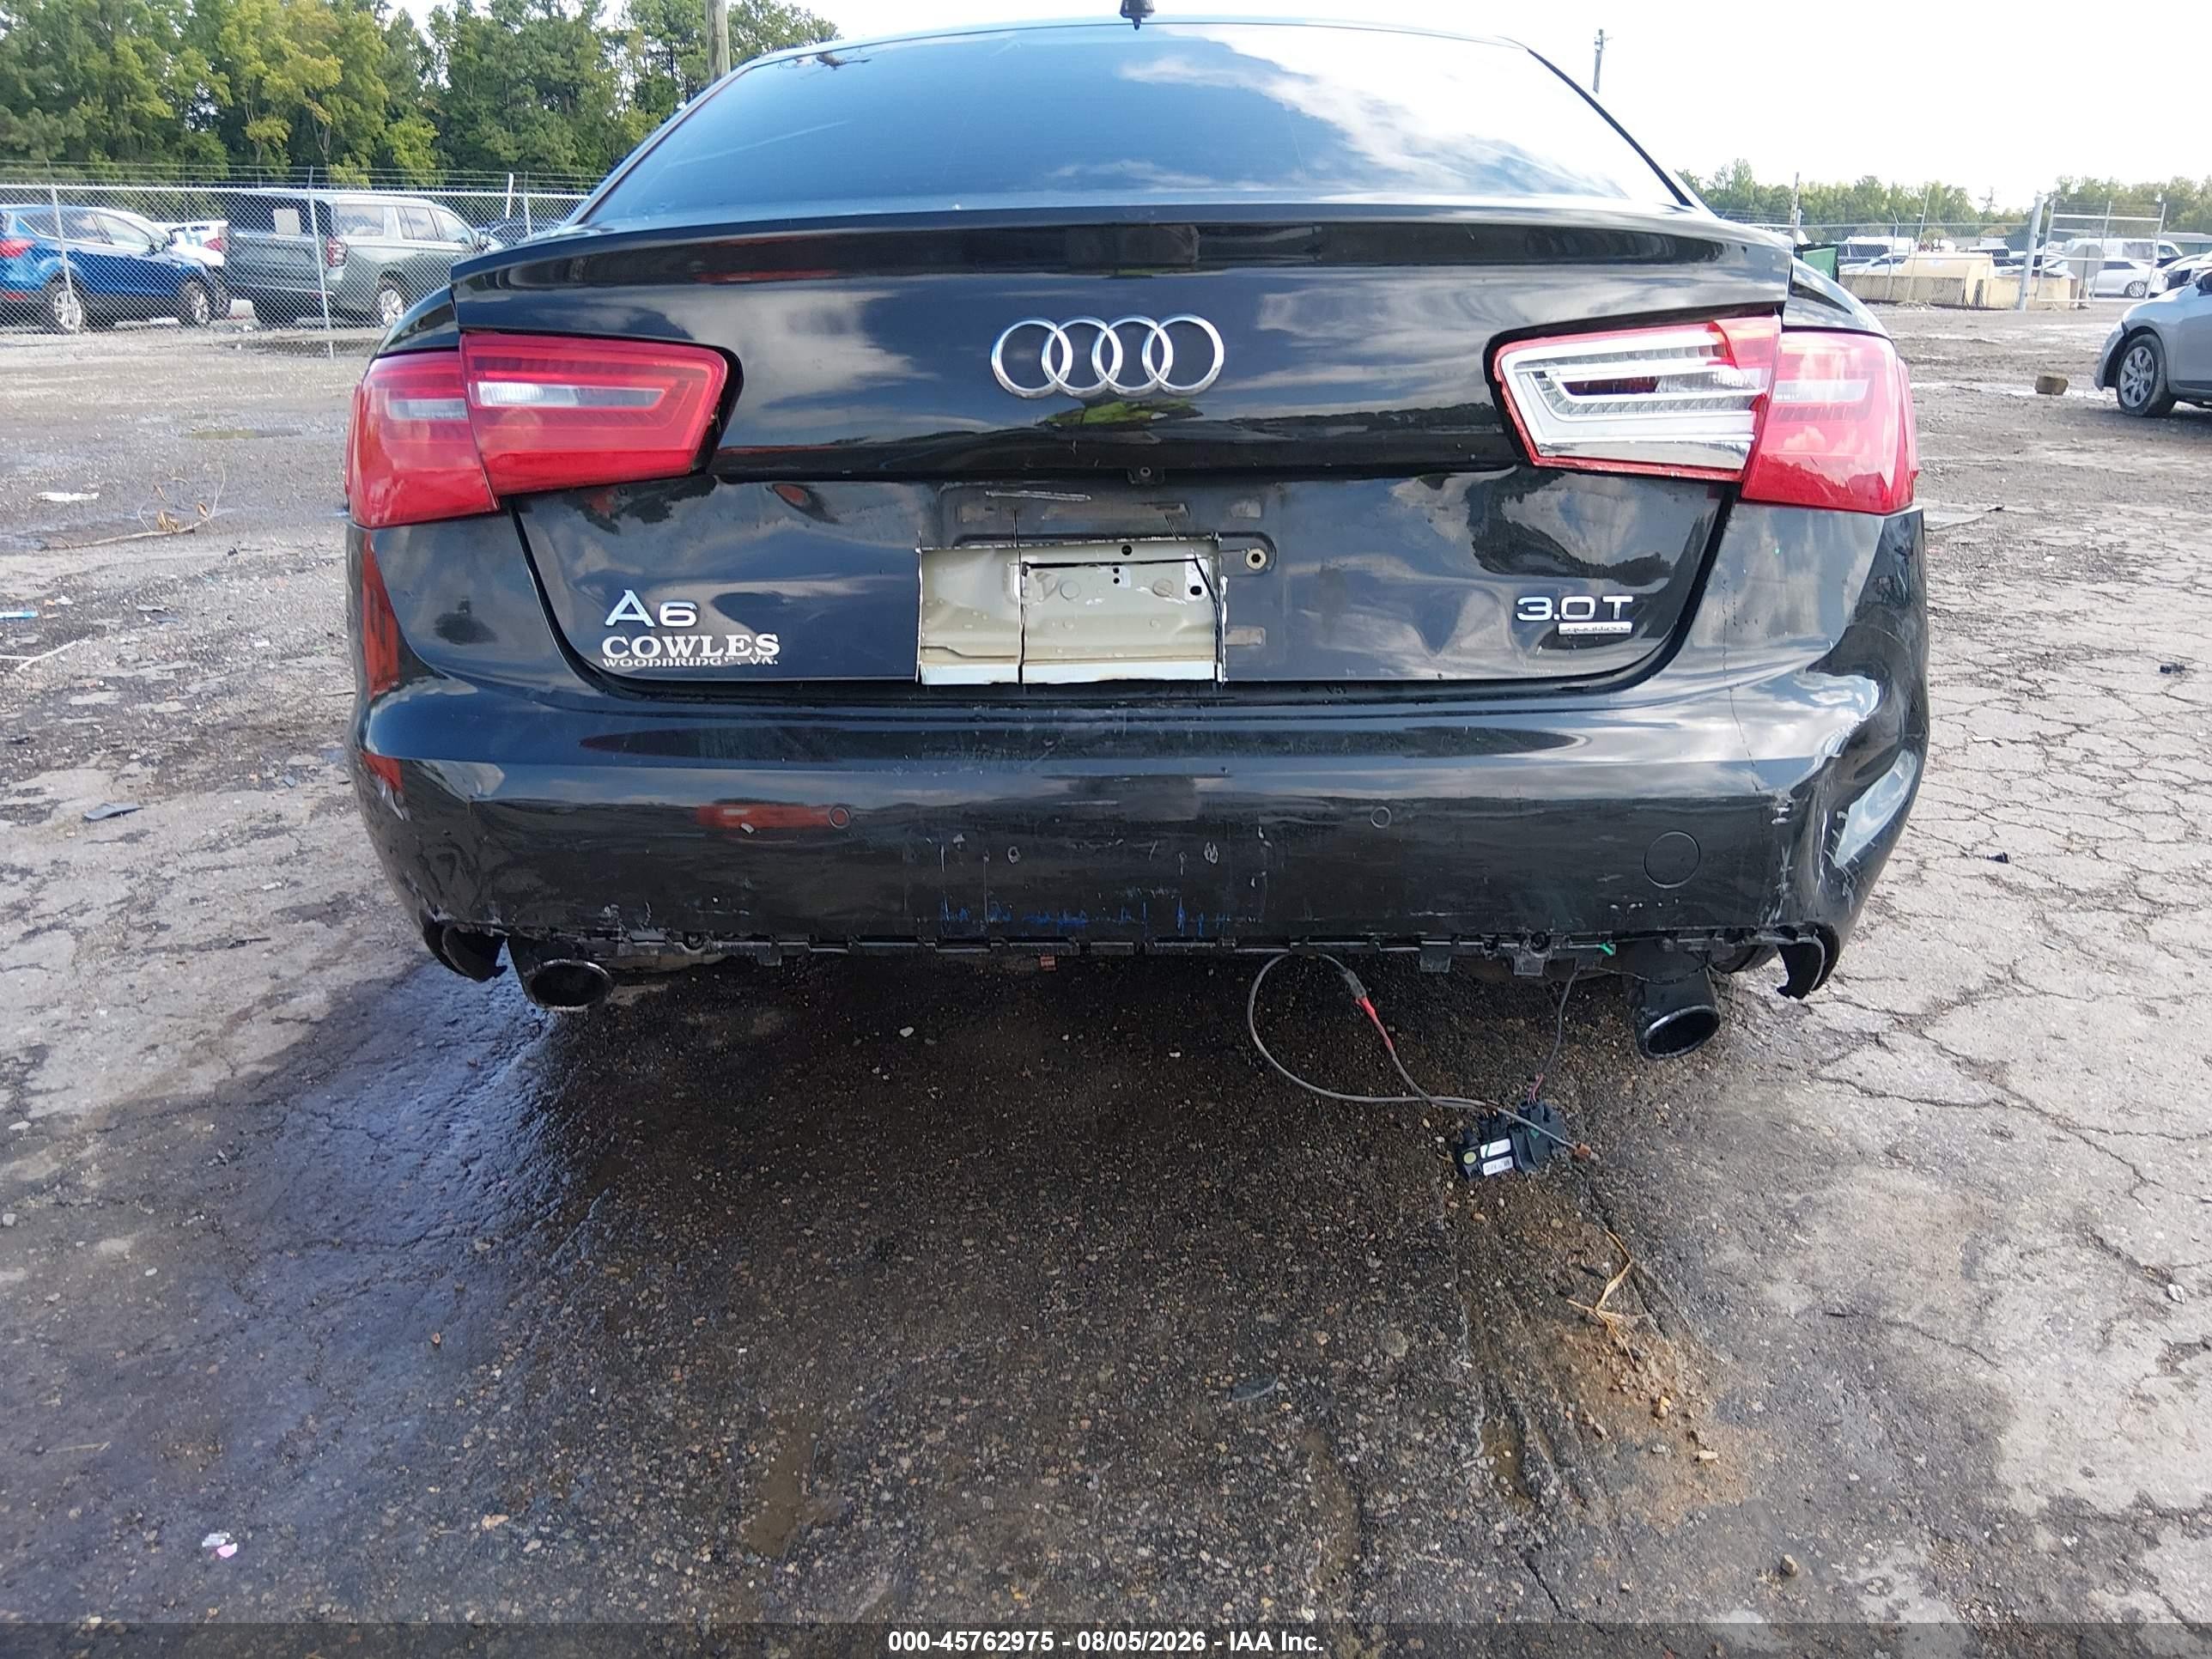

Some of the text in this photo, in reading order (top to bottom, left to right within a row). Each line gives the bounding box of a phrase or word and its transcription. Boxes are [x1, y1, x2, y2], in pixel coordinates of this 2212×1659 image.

[605, 589, 698, 628] A6
[1516, 595, 1633, 621] 3.0T
[602, 634, 781, 659] COWLES
